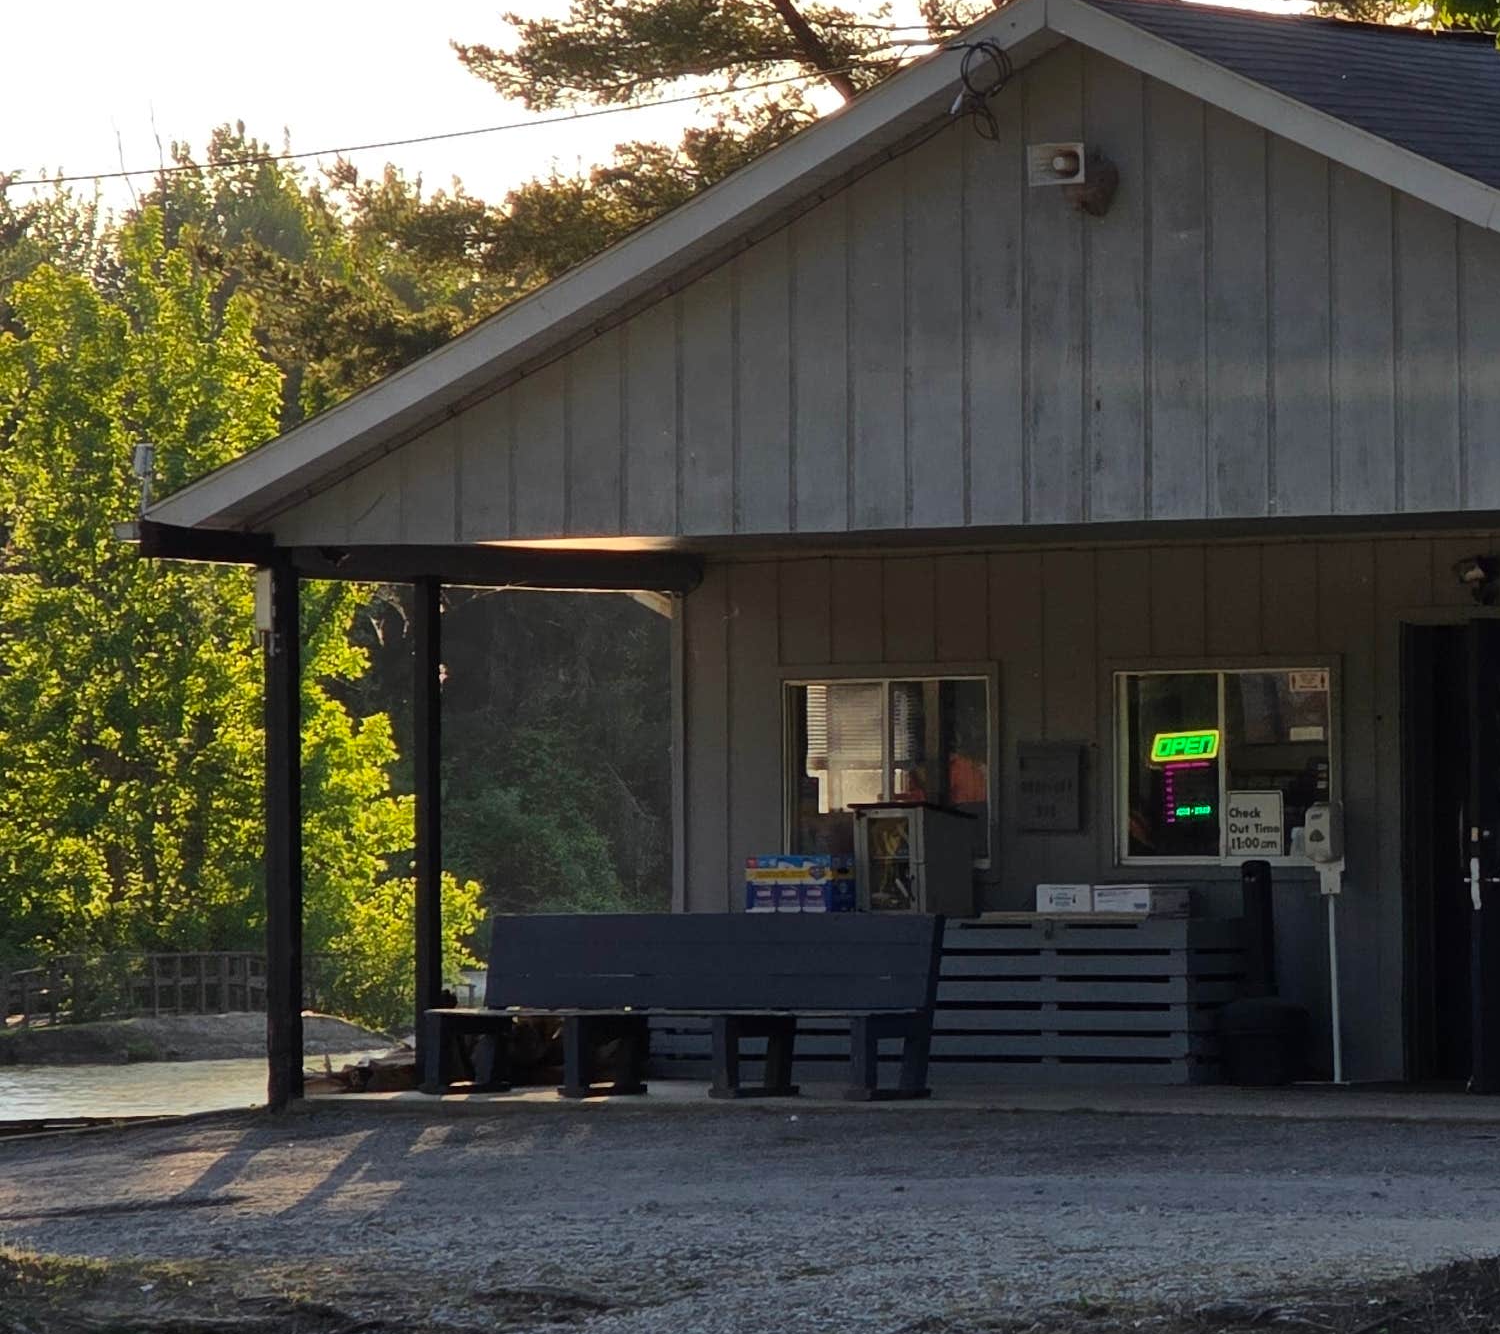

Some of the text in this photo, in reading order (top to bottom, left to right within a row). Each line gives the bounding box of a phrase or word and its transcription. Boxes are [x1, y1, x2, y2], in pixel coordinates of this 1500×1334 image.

[1157, 735, 1214, 756] OPEN
[1229, 806, 1261, 819] Check
[1229, 823, 1280, 834] Out Time
